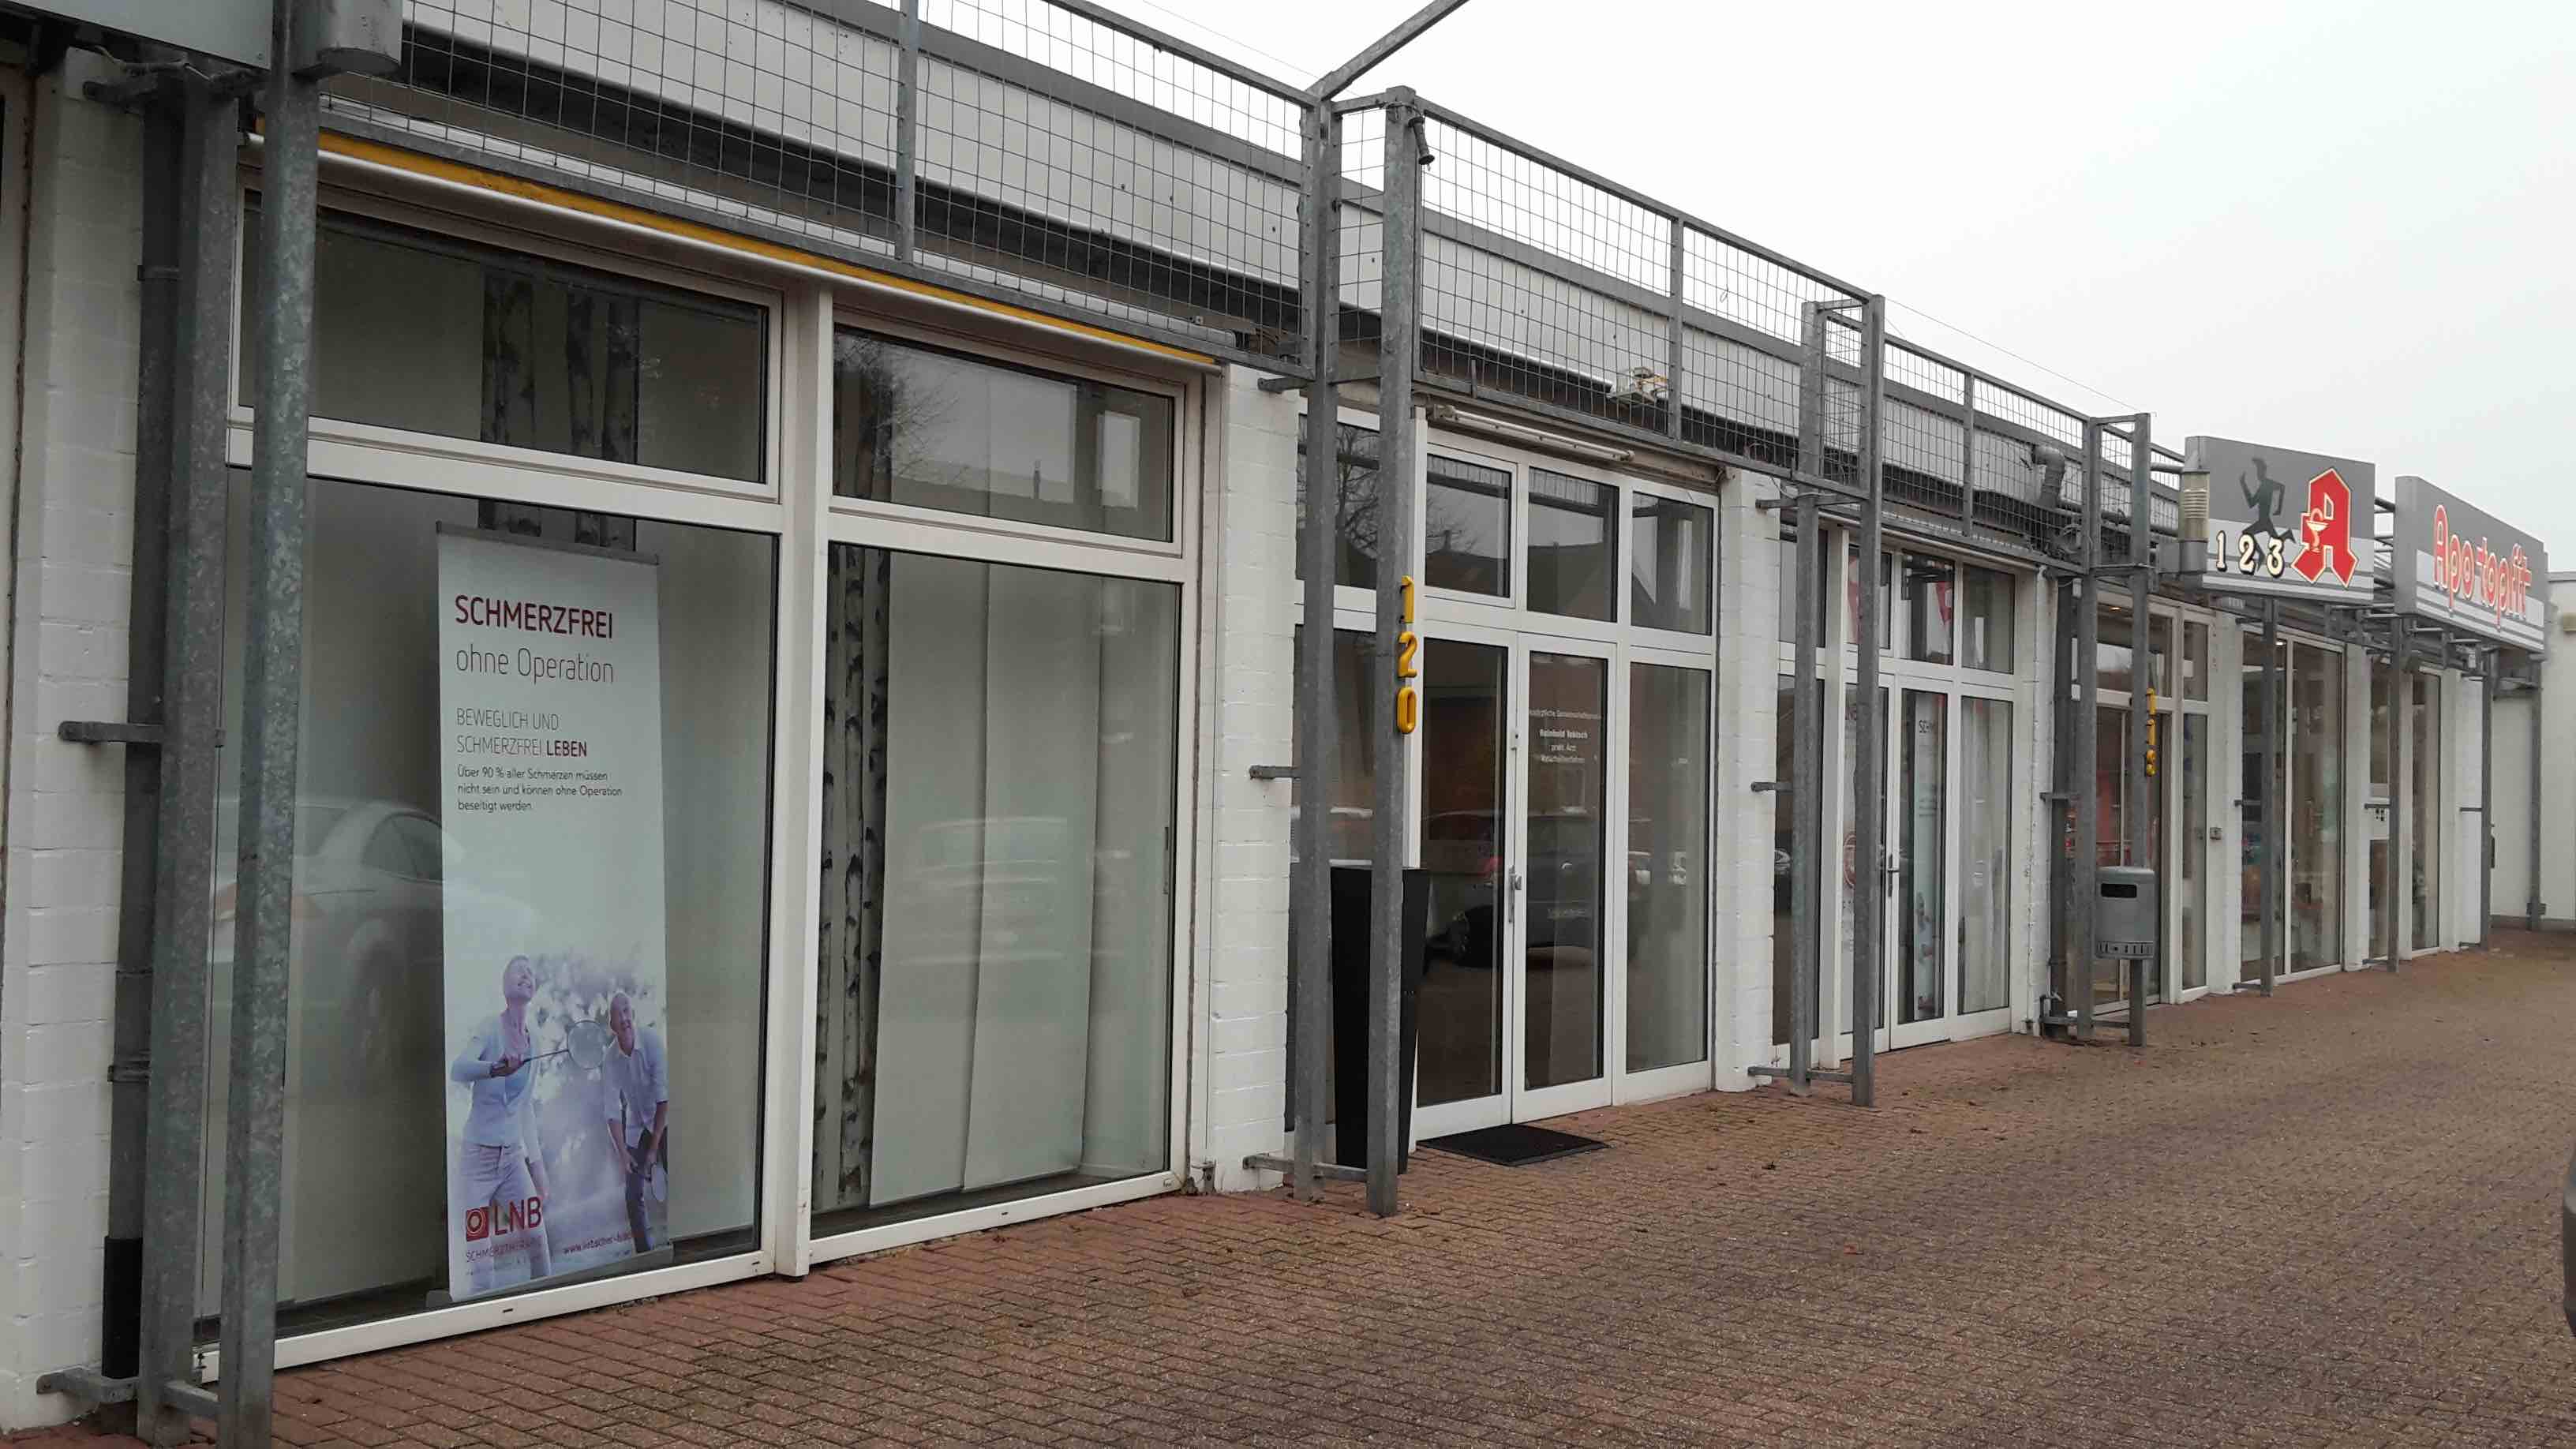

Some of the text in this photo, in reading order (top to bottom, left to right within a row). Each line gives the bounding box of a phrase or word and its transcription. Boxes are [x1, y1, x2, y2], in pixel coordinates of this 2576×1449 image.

[455, 594, 612, 639] SCHMERZFREI
[455, 643, 613, 685] ohne Operation
[1396, 574, 1418, 735] 120
[456, 707, 560, 731] BEWEGLICH UND
[456, 735, 587, 758] SCHMERZFREI LEBEN
[457, 764, 608, 781] Über 90 % aller Schmerzen müssen
[457, 782, 623, 798] nicht sein und können ohne Operation
[458, 799, 498, 814] beseitigt
[493, 1196, 543, 1236] LNB
